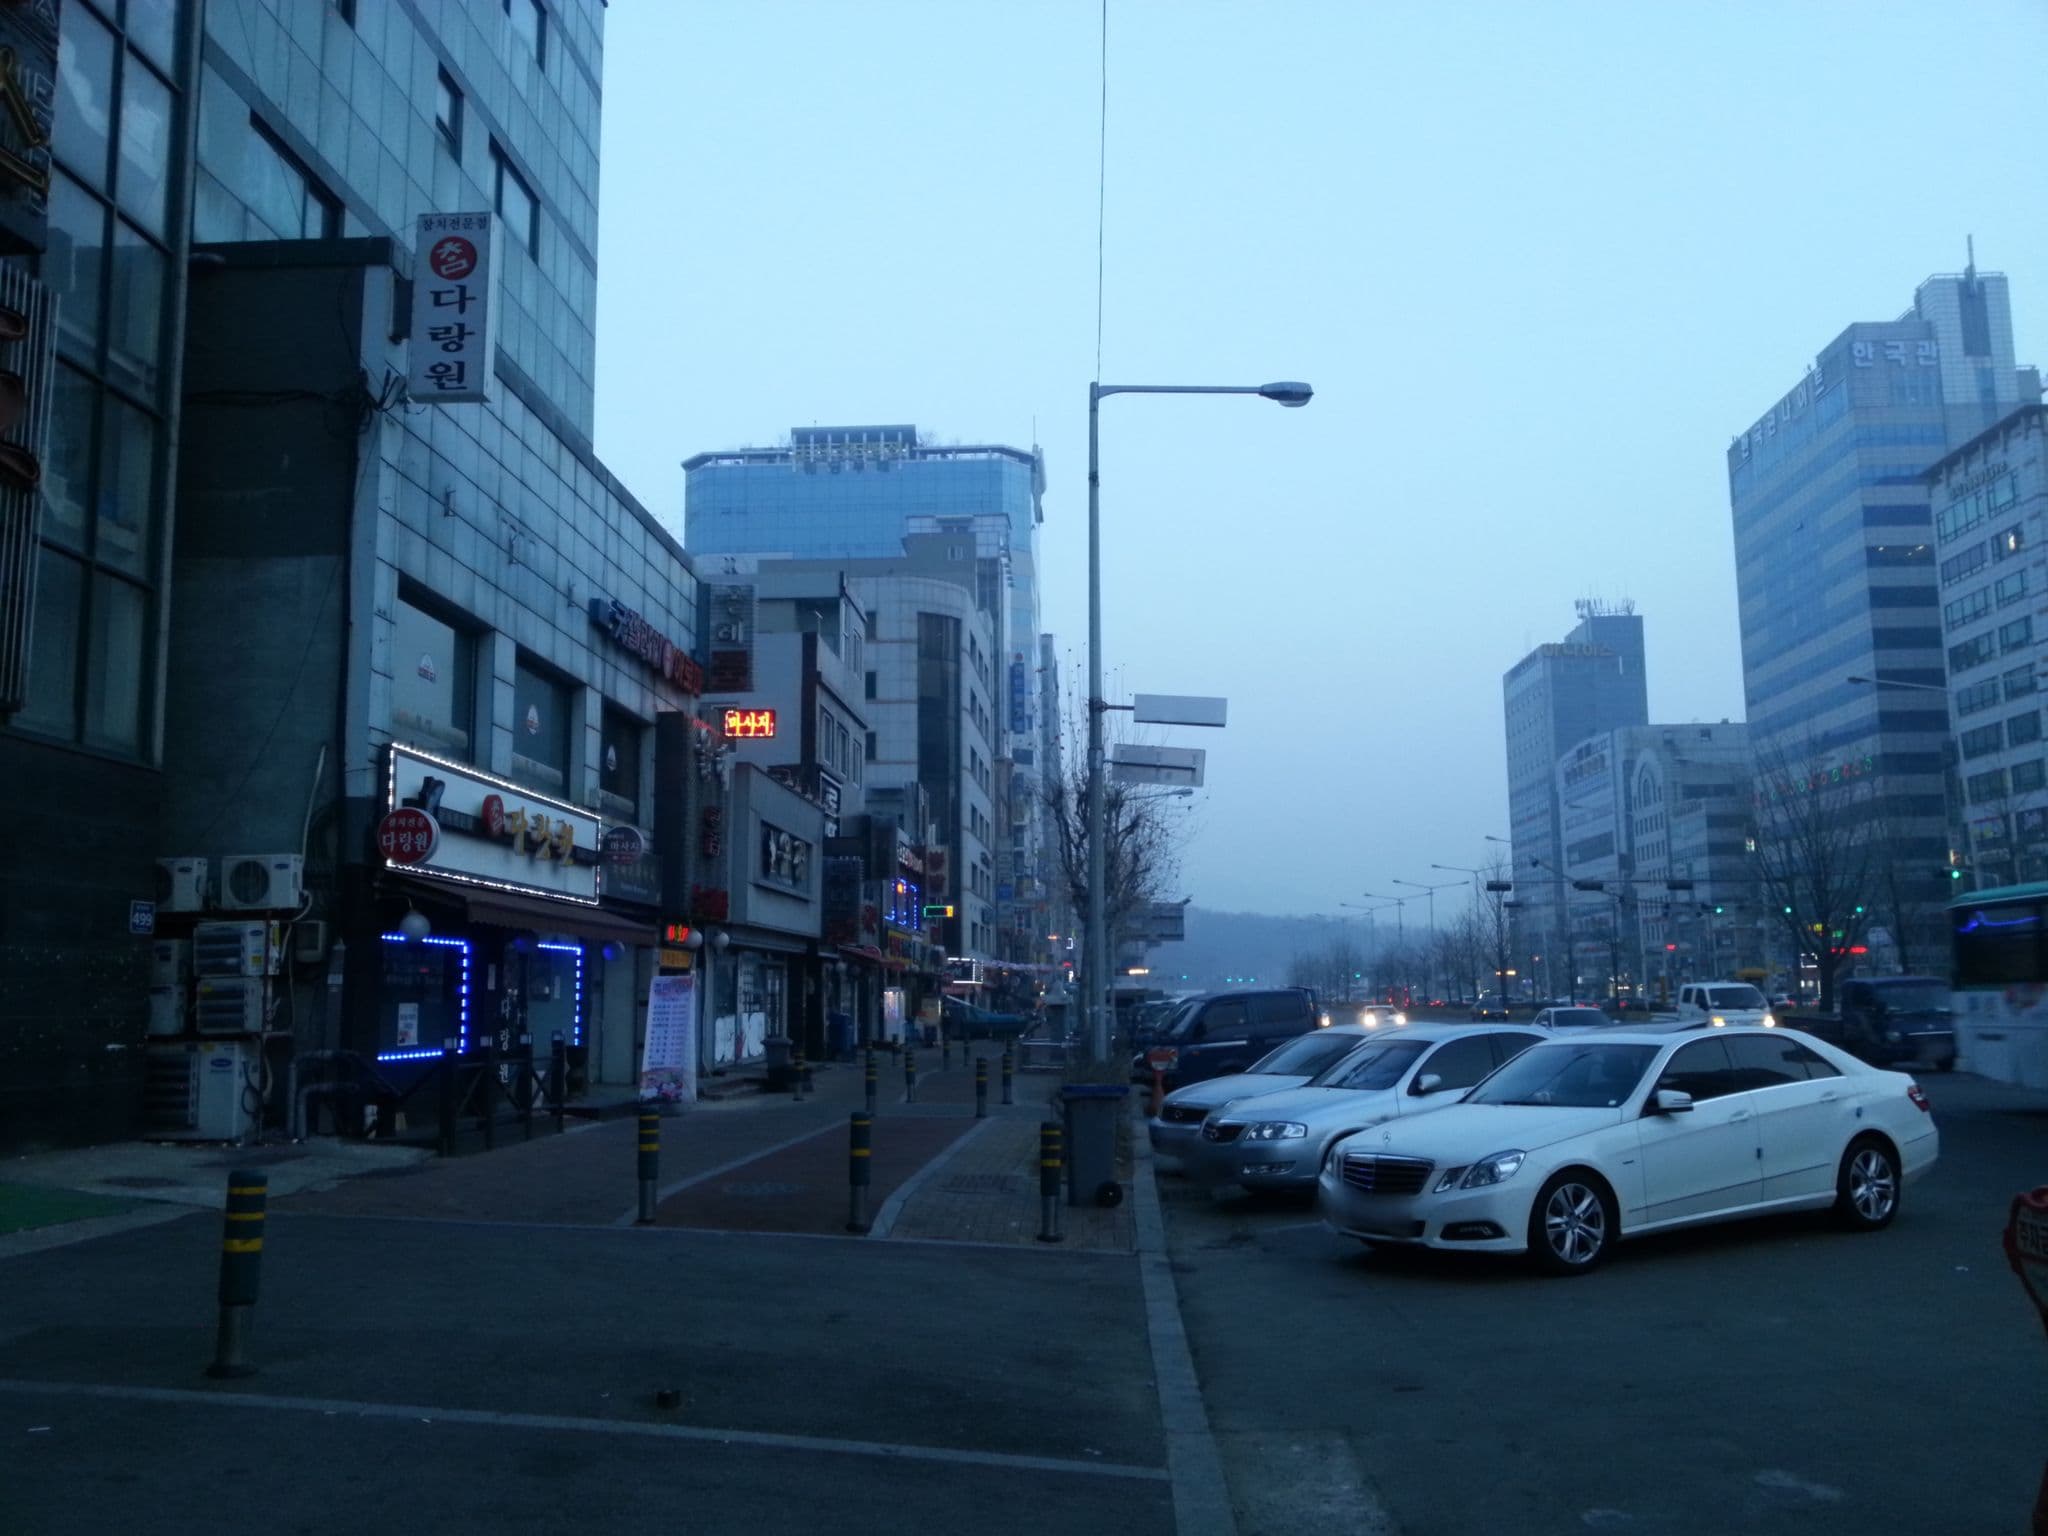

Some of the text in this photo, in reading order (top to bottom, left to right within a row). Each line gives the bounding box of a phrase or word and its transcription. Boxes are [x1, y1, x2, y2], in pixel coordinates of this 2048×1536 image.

[424, 284, 477, 390] 다랑원
[1852, 340, 1938, 368] 한국관
[728, 711, 772, 736] 마사지
[382, 830, 429, 854] 다랑원
